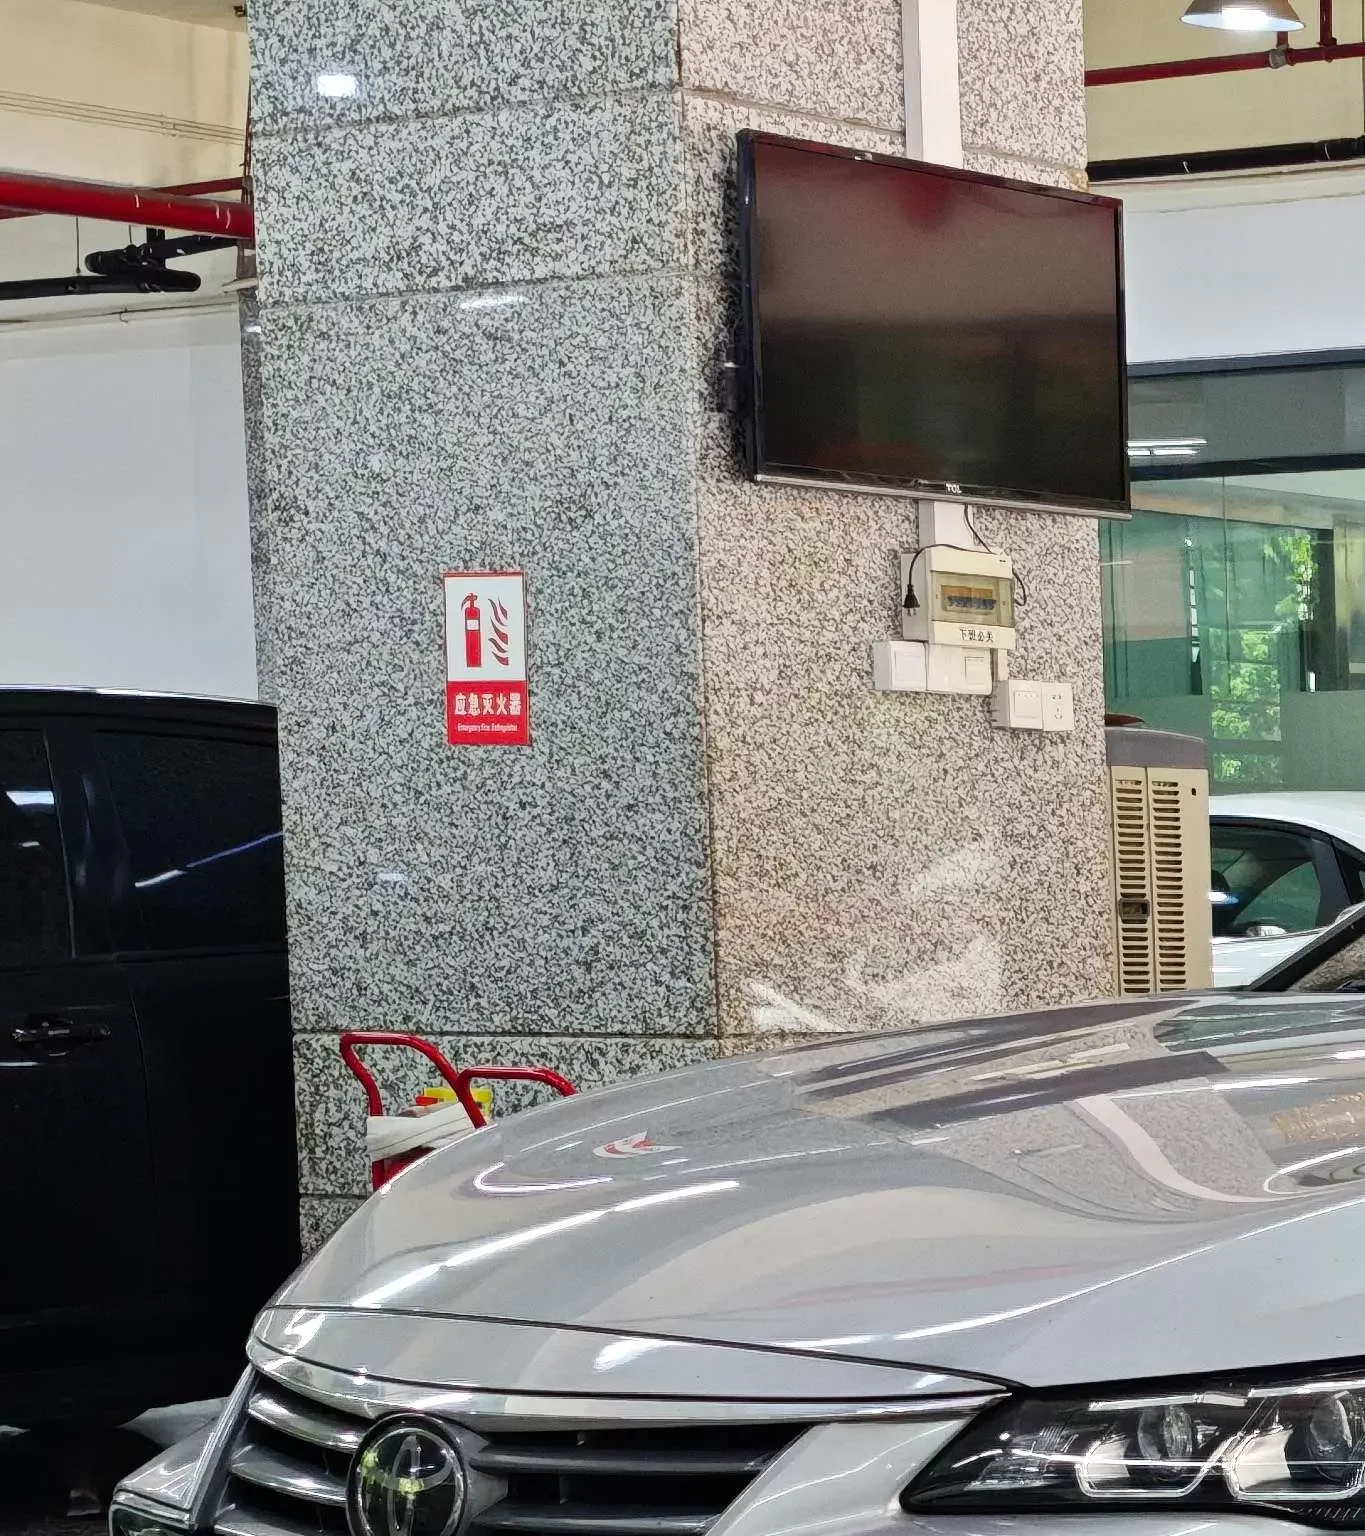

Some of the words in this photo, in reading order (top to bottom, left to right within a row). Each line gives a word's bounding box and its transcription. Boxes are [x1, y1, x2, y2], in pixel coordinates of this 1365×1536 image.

[455, 692, 522, 716] 应急灭火器
